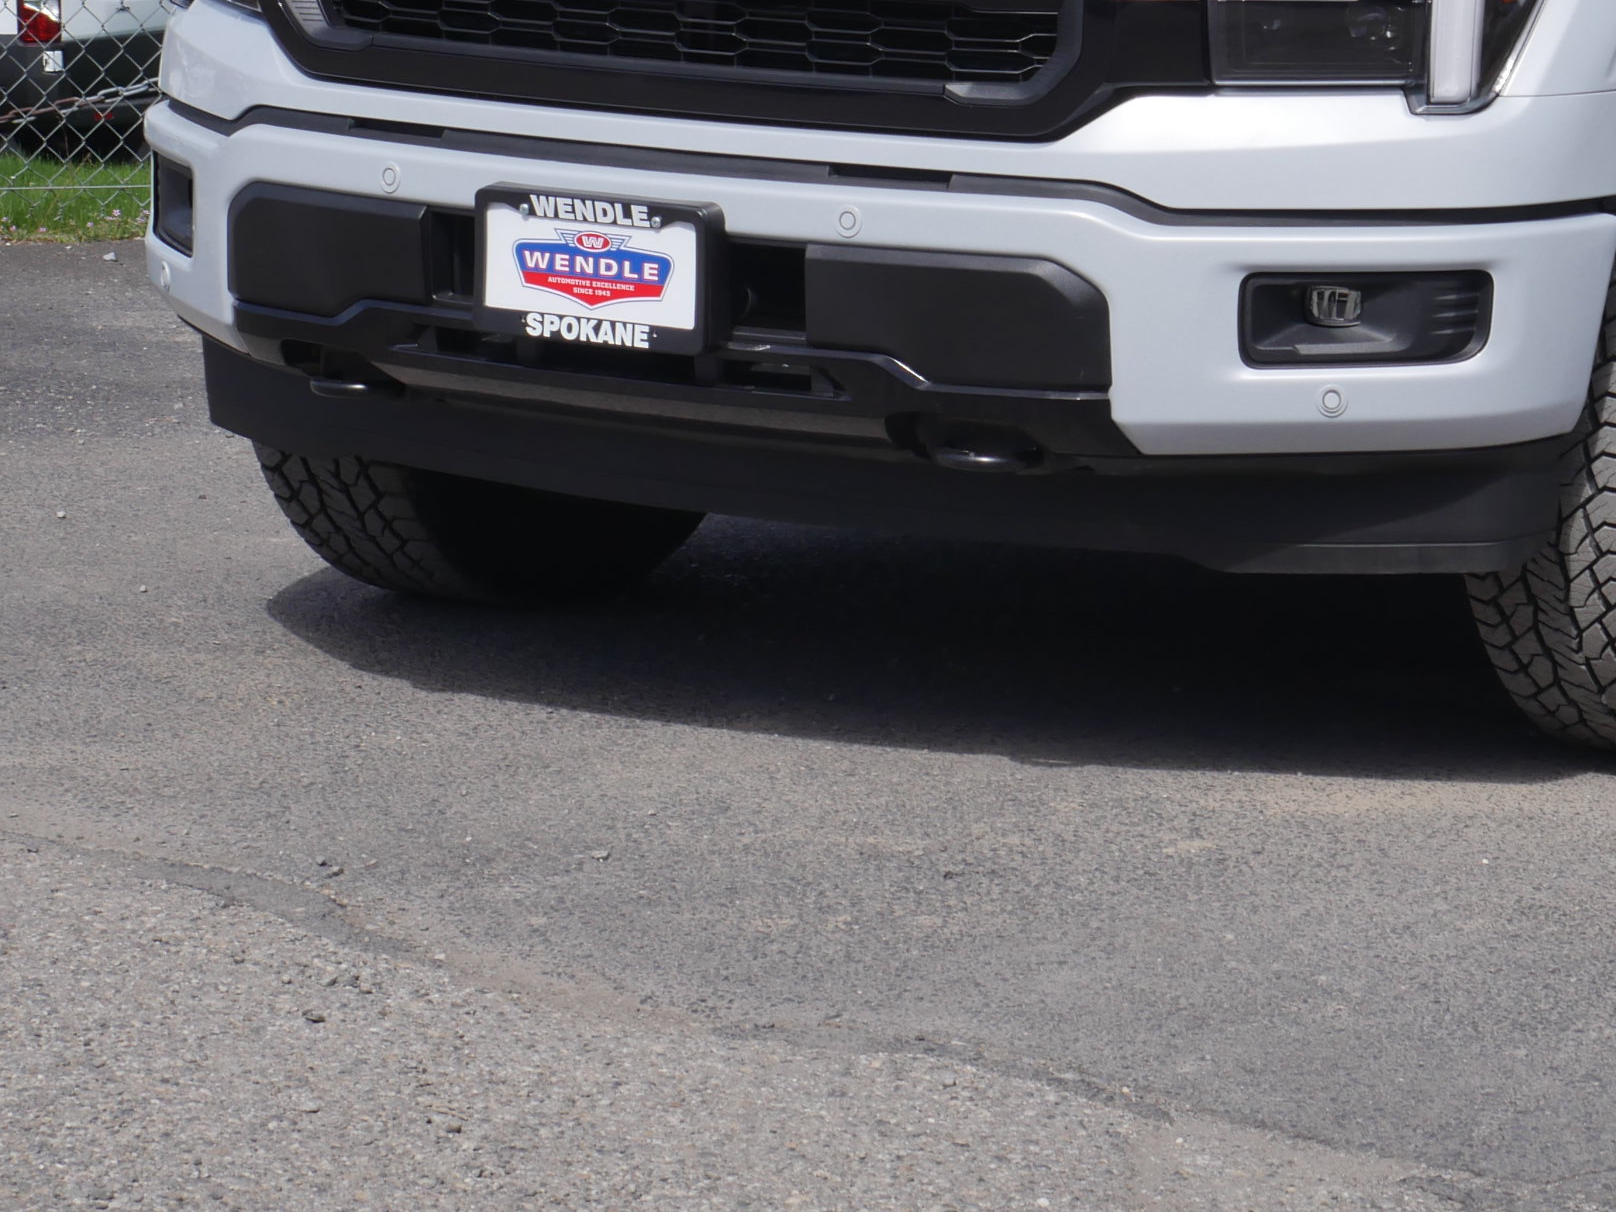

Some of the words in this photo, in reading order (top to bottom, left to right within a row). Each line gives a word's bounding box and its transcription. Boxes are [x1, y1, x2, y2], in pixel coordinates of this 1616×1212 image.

[530, 194, 651, 228] WENDLE
[581, 235, 604, 249] W
[523, 250, 660, 281] WENDLE
[548, 276, 591, 287] AUTOMOTIVE
[592, 281, 635, 292] EXCELLENCE
[573, 287, 593, 295] SINCE
[525, 312, 650, 349] SPOKANE
